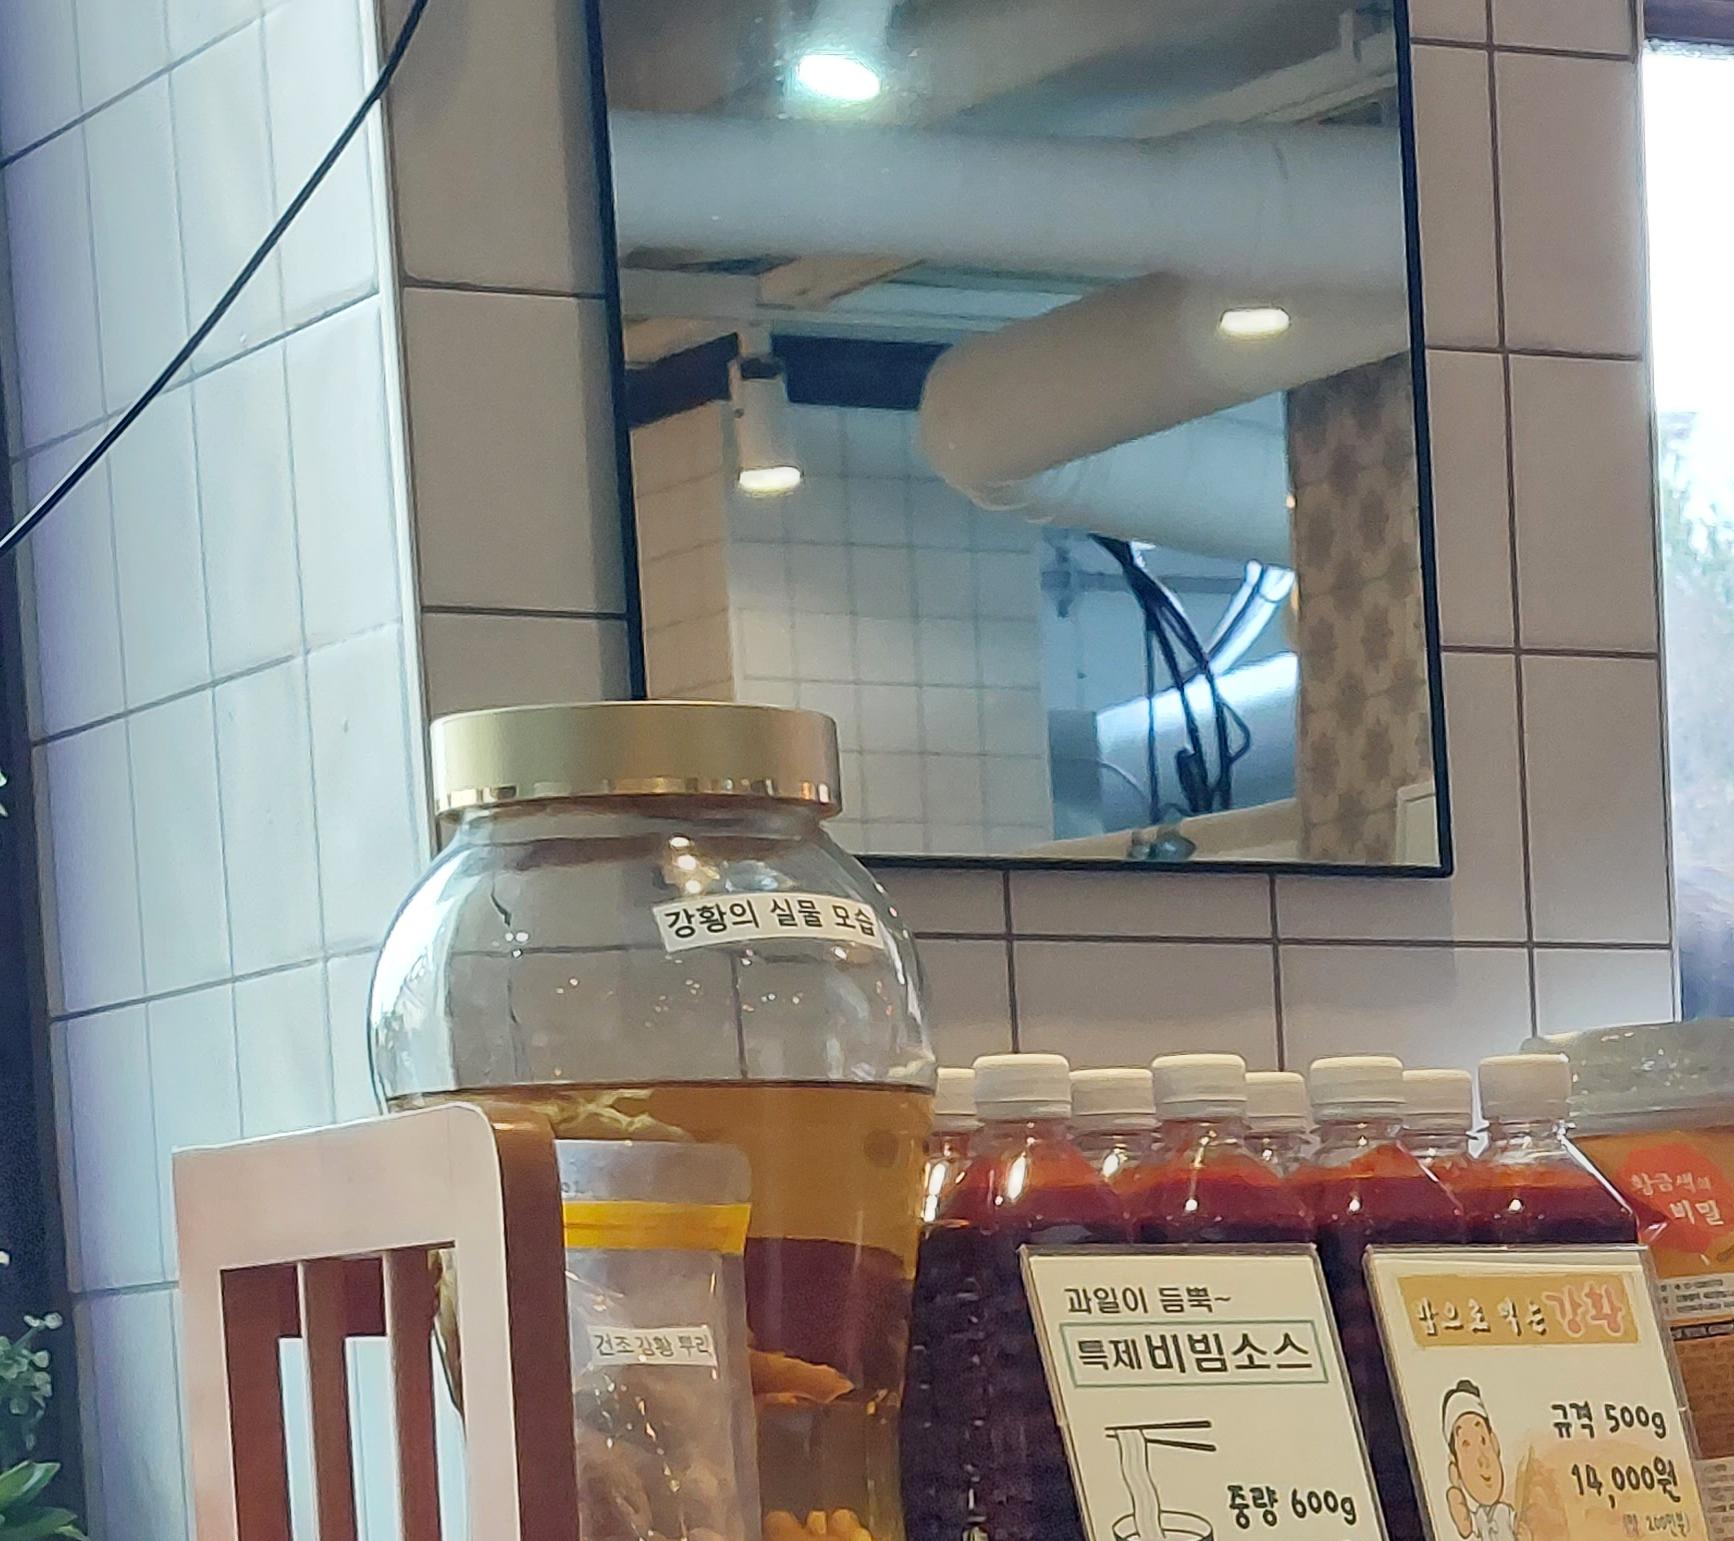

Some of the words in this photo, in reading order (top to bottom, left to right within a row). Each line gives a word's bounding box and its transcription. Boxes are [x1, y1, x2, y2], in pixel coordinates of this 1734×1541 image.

[665, 899, 759, 938] 강황의
[770, 898, 823, 928] 실물
[832, 904, 876, 937] 모습
[1669, 1199, 1725, 1226] 비밀
[1064, 1287, 1149, 1314] 과일이
[1551, 1401, 1595, 1439] 규격
[1604, 1403, 1667, 1439] 500g
[1571, 1456, 1681, 1509] 14,000원
[1227, 1484, 1278, 1530] 중량
[1291, 1488, 1357, 1526] 600g
